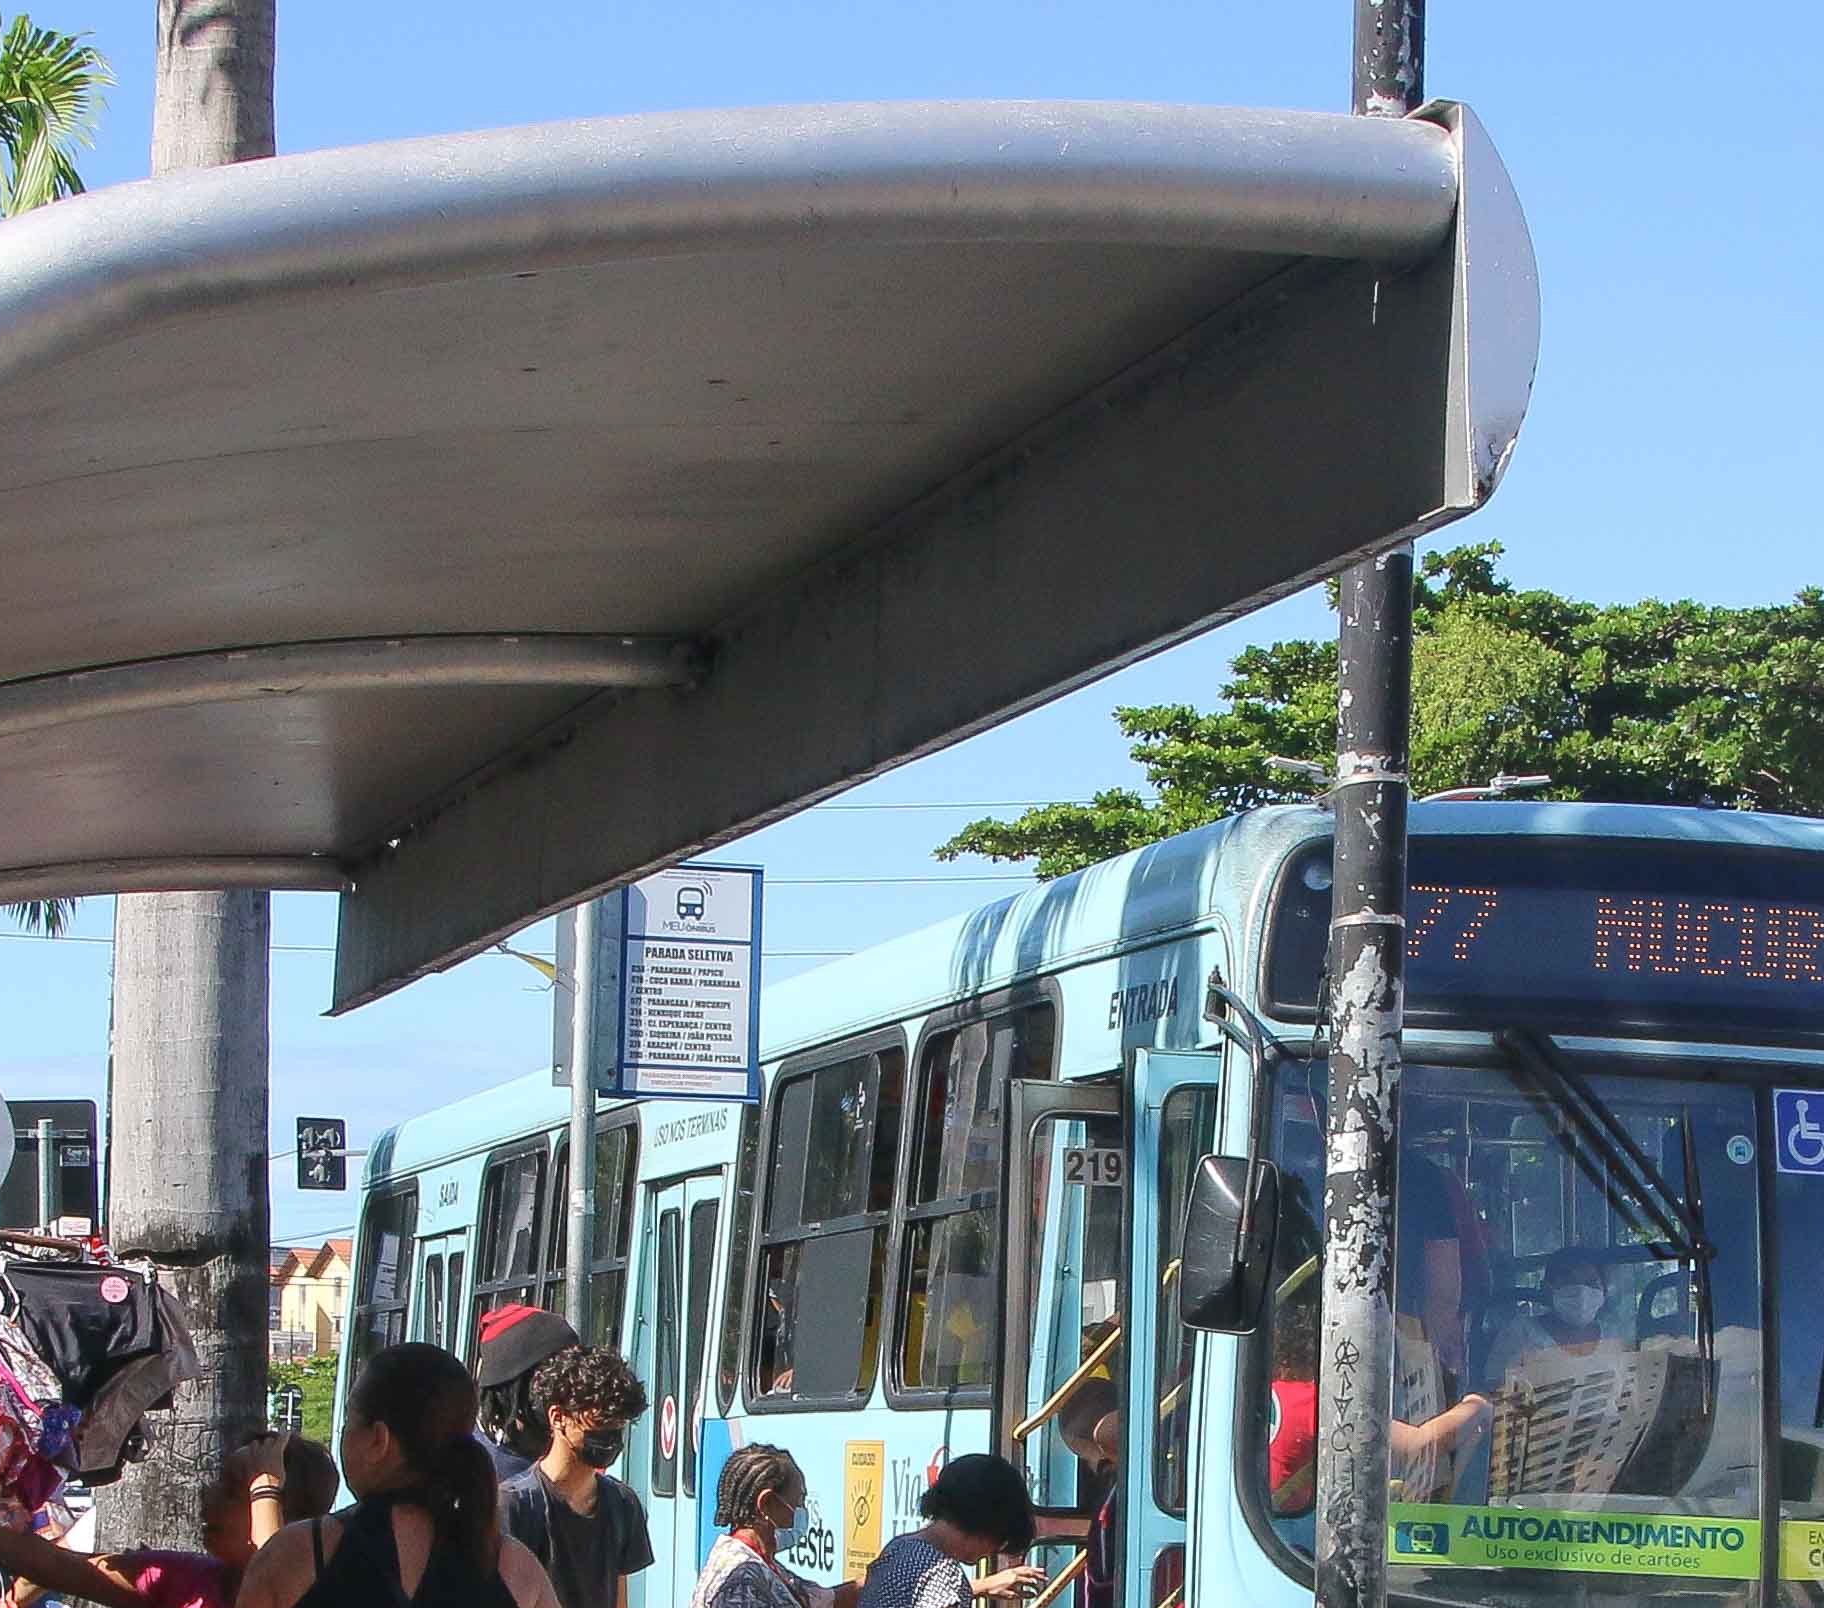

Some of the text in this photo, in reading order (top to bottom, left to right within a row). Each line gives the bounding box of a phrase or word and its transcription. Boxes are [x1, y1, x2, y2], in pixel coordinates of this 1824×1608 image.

[1407, 884, 1498, 960] 77
[646, 947, 734, 962] PARADA SELETIVA
[1108, 976, 1178, 1030] ENTRADA
[687, 1107, 729, 1140] TERMINAIS
[1067, 1152, 1122, 1182] 219
[1461, 1516, 1745, 1551] AUTOATENDIMENTO
[1485, 1544, 1700, 1569] Uso exclusivo de cartões
